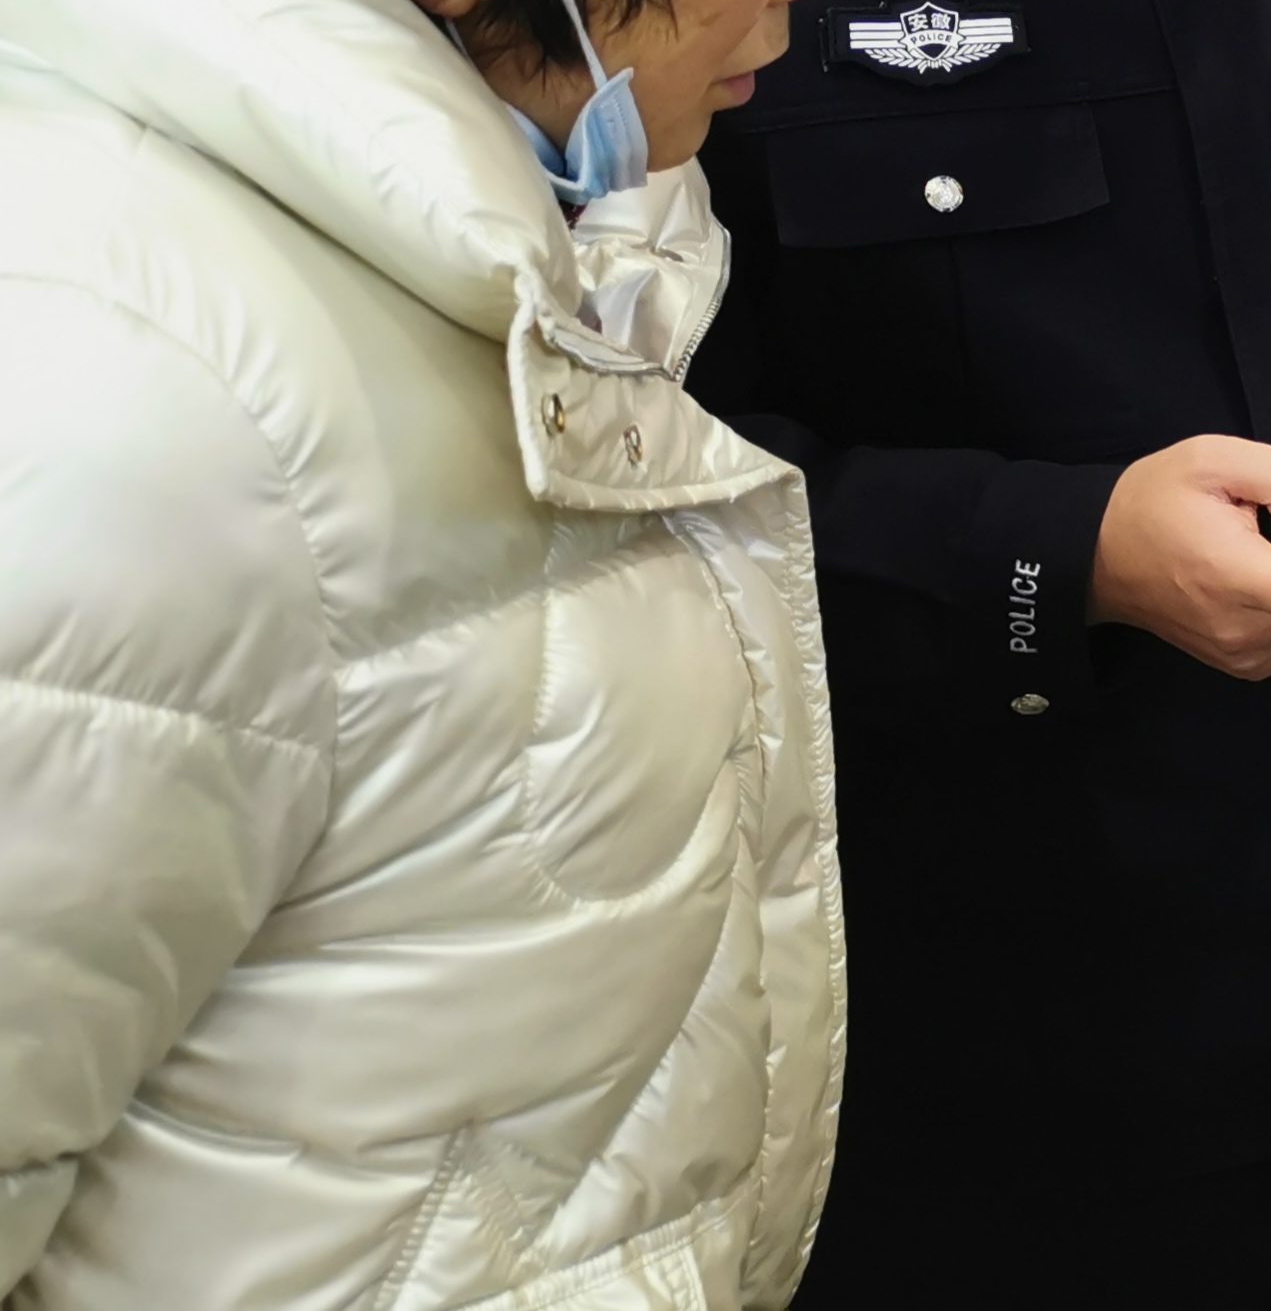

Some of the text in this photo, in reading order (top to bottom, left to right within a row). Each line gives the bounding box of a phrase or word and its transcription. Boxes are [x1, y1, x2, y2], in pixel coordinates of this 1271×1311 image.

[907, 12, 952, 32] 安徽
[910, 32, 953, 45] POLICE
[1007, 559, 1041, 654] POLICE
